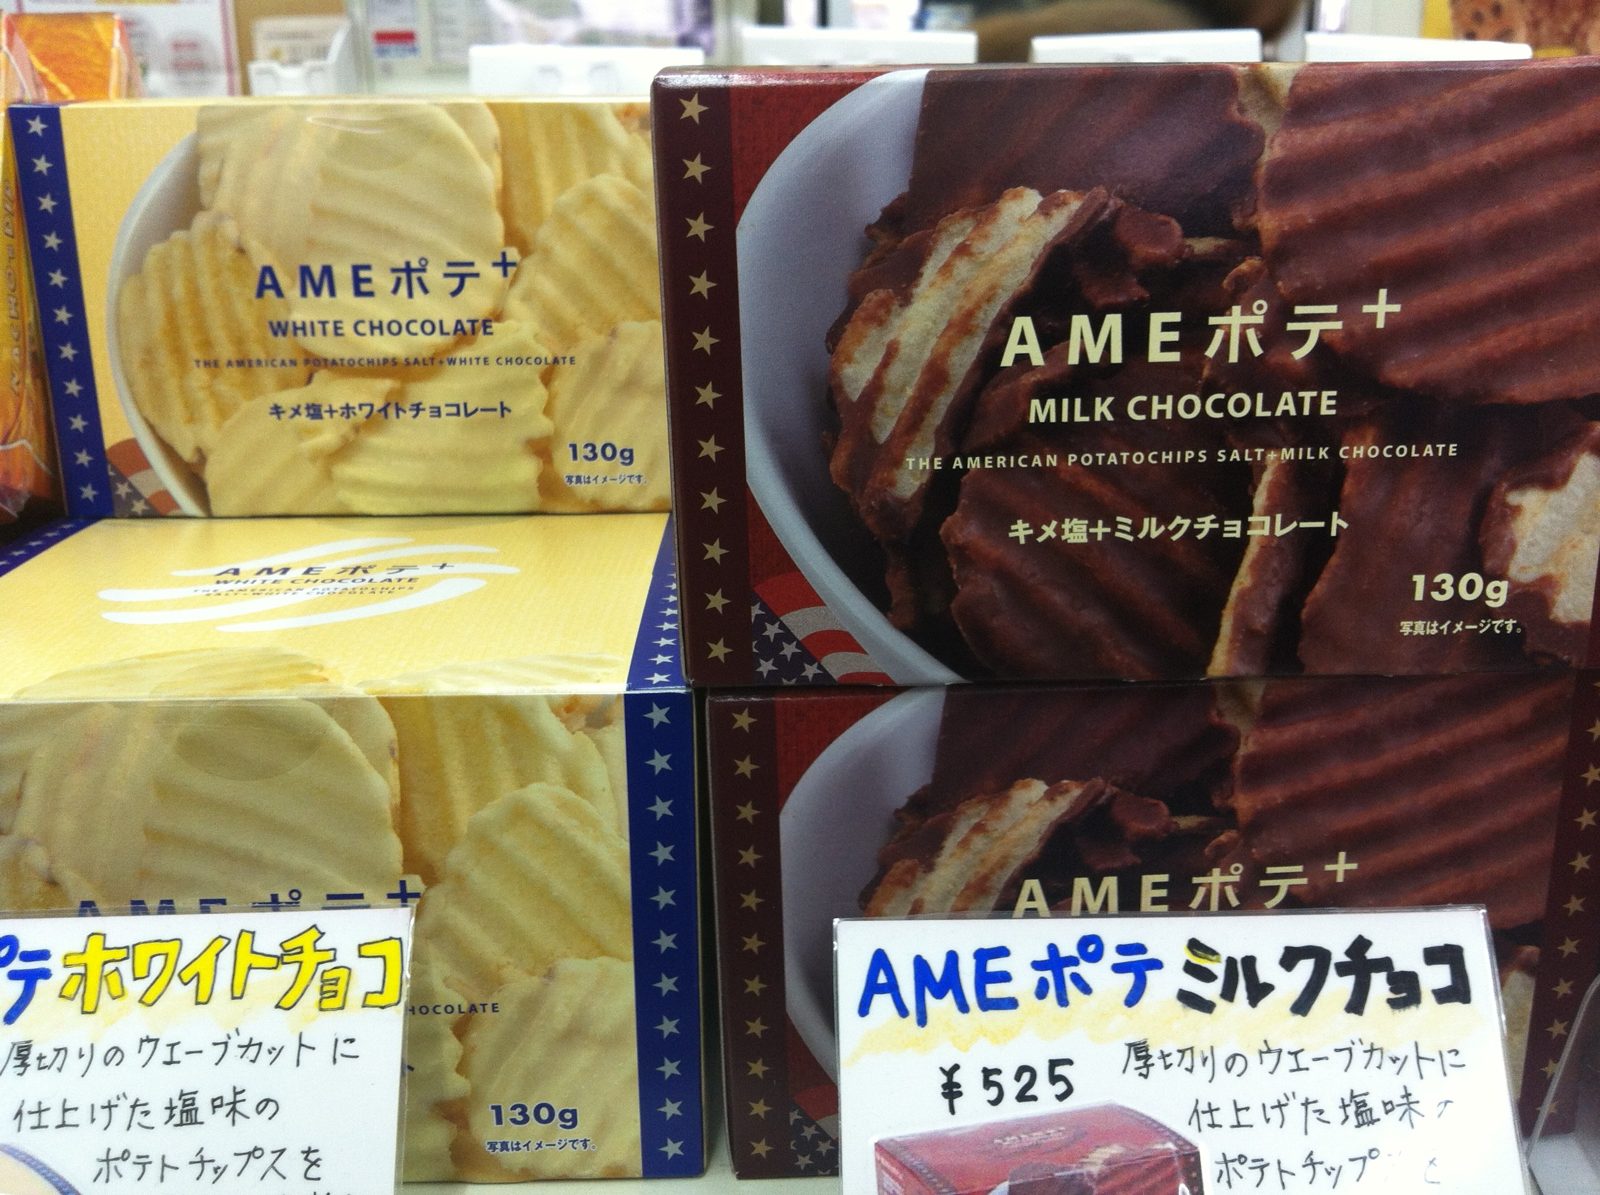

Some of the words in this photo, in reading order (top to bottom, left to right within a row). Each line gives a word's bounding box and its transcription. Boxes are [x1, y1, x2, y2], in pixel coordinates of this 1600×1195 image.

[269, 320, 345, 337] WHITE
[353, 319, 494, 337] CHOCOLATE
[195, 359, 220, 369] THE
[226, 358, 298, 368] AMERICAN
[303, 357, 399, 367] POTATOCHIPS
[495, 355, 577, 366] CHOCOLATE
[1029, 397, 1115, 424] MILK
[1127, 390, 1338, 420] CHOCOLATE
[568, 442, 634, 467] 130g
[906, 456, 943, 471] THE
[952, 453, 1058, 470] AMERICAN
[1068, 449, 1208, 467] POTATOCHIPS
[1339, 443, 1459, 460] CHOCOLATE
[1411, 572, 1510, 608] 130g
[406, 1002, 500, 1015] HOCOLATE
[490, 1102, 578, 1130] 130g
